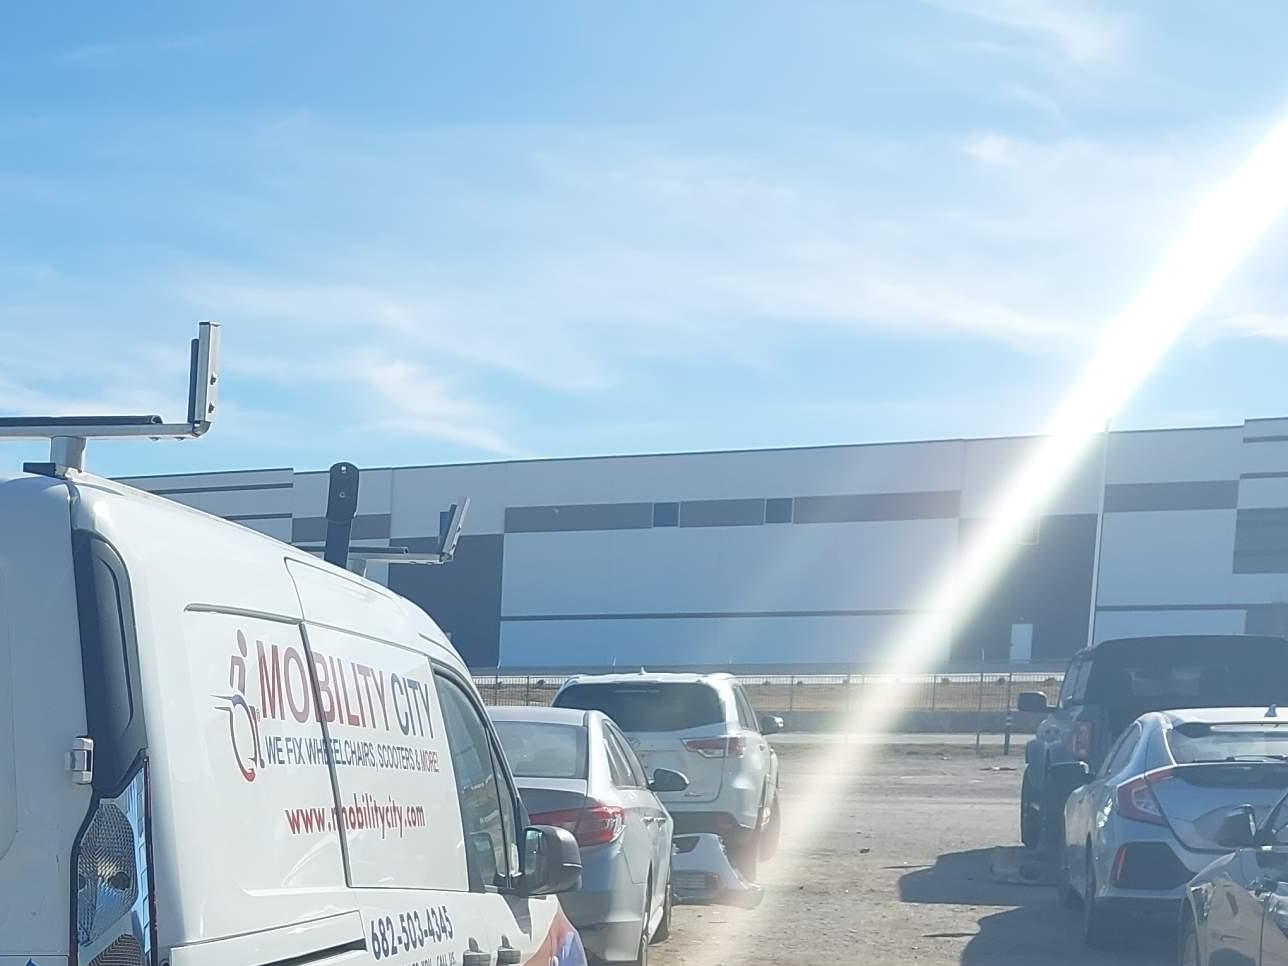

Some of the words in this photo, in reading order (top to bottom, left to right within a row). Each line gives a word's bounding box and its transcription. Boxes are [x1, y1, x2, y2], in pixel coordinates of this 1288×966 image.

[256, 640, 390, 731] MOBILITY
[390, 672, 434, 739] CITY
[265, 736, 286, 764] WE
[286, 737, 306, 765] FIX
[377, 744, 415, 770] SCOOTERS
[285, 793, 425, 839] www.mobilitycity.com
[371, 906, 453, 960] 682-503-4345
